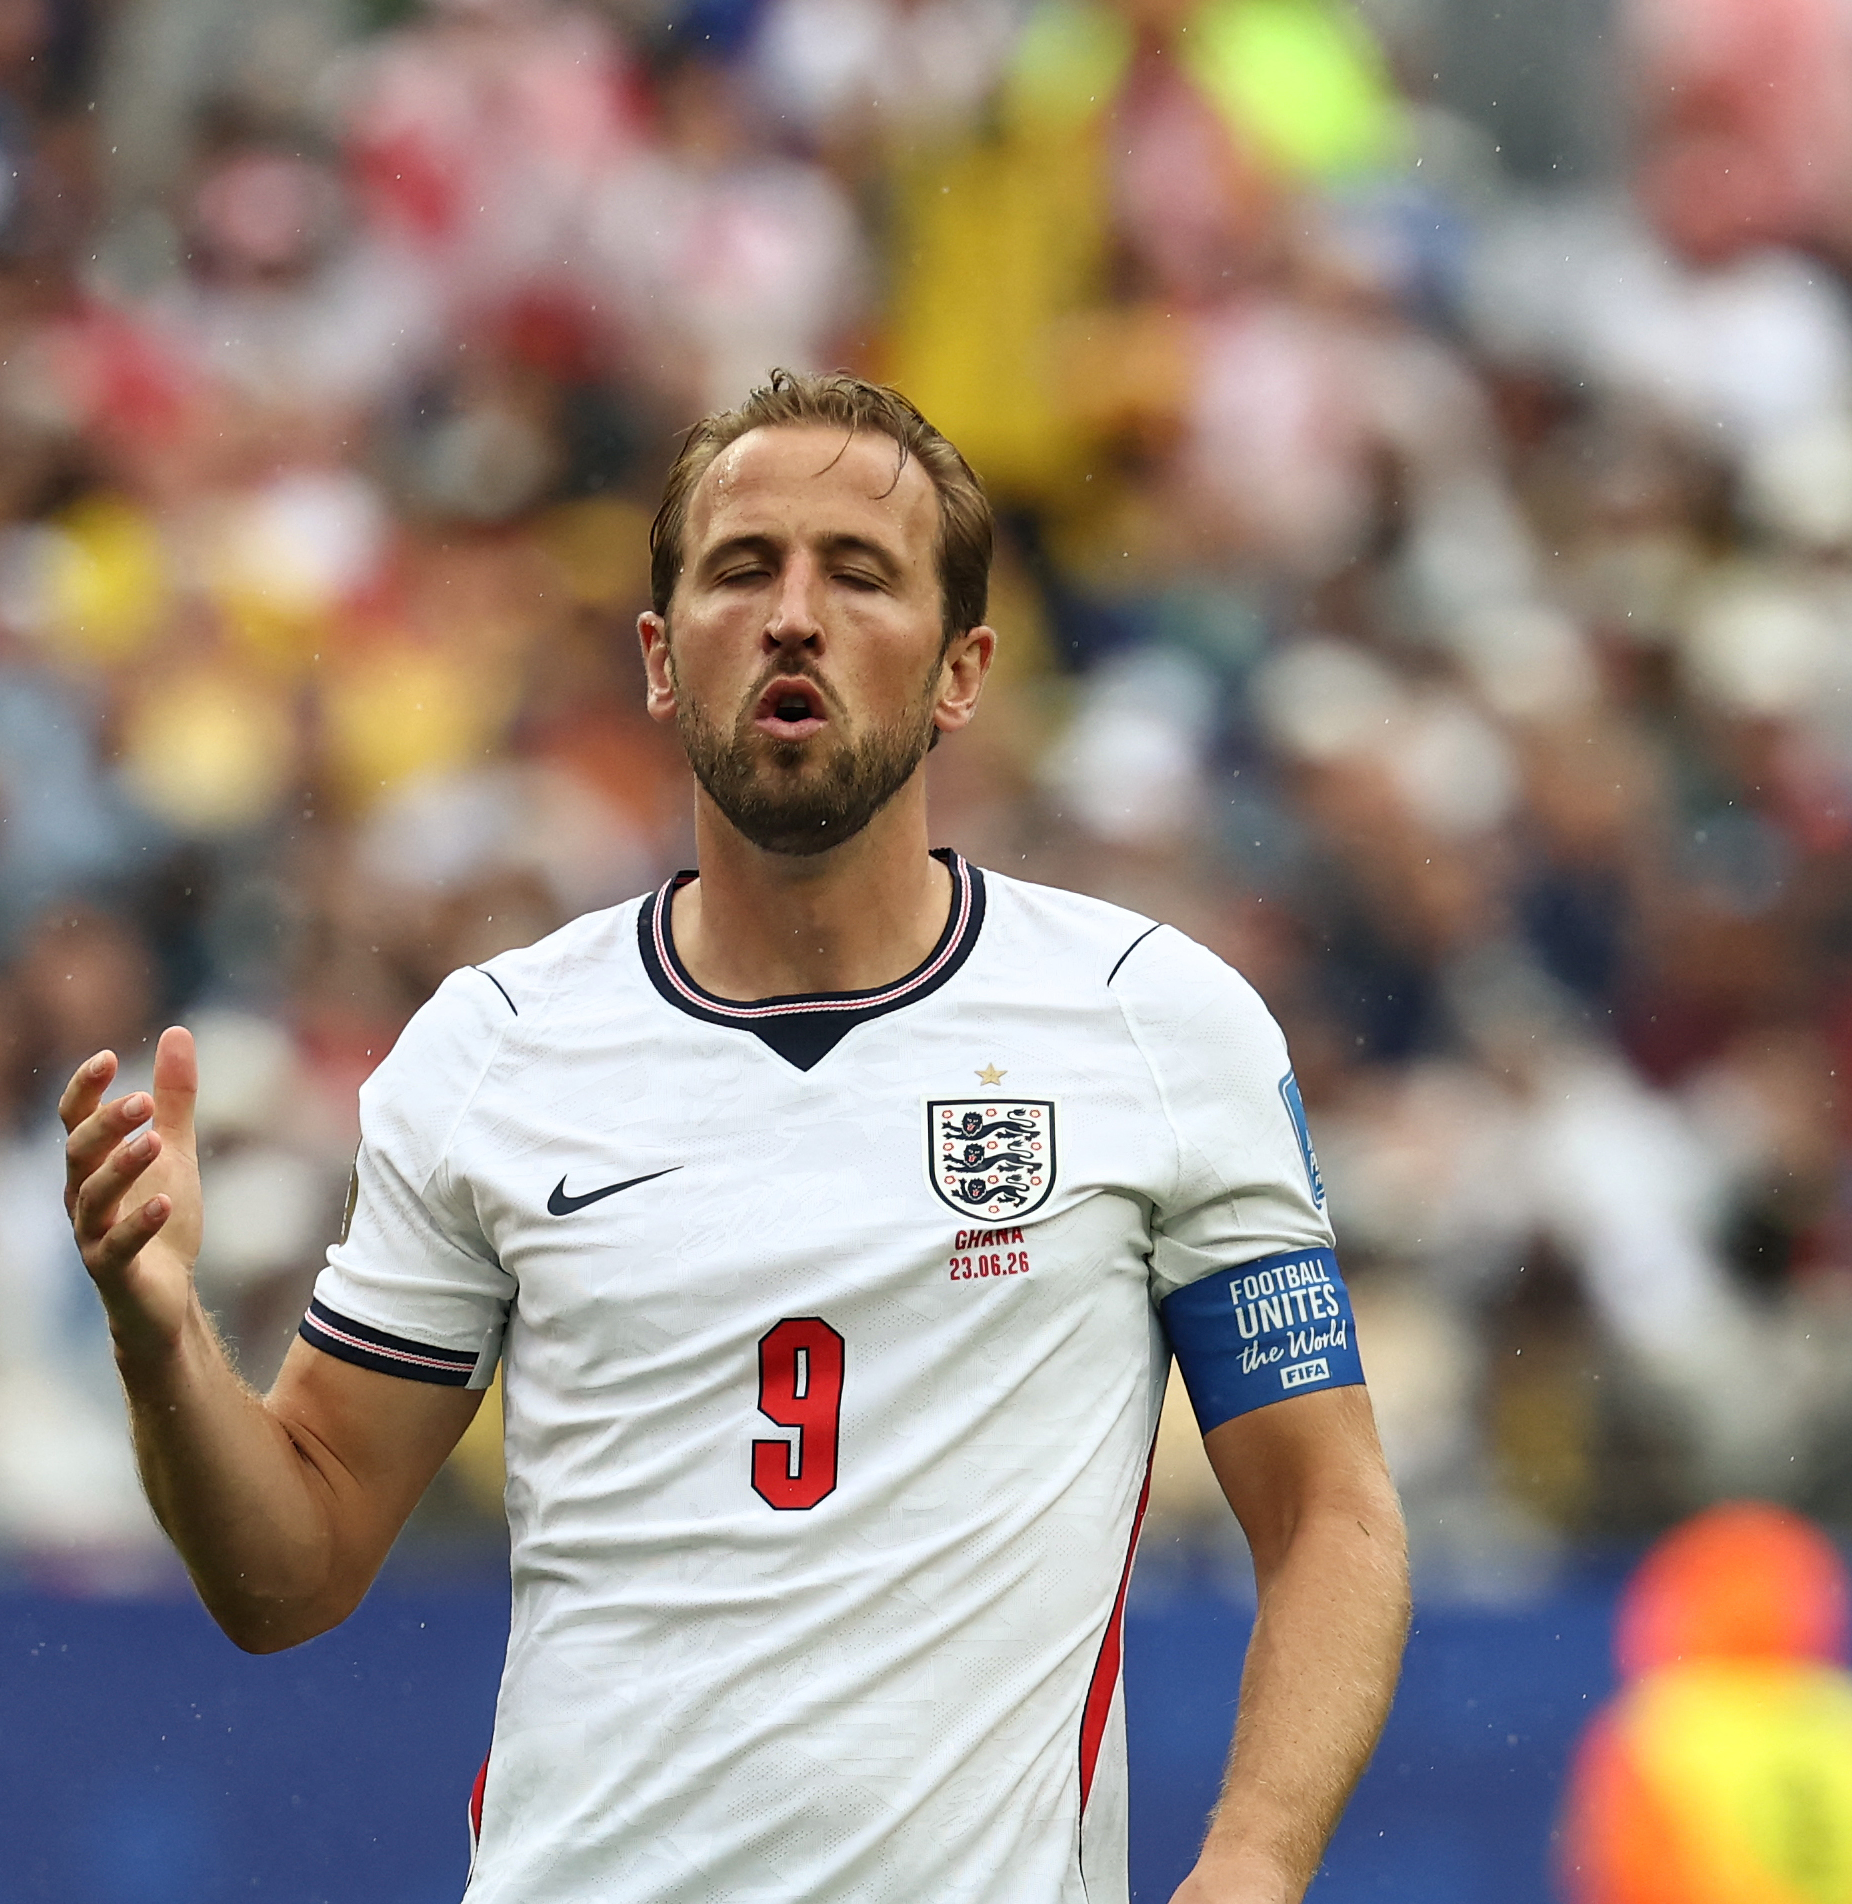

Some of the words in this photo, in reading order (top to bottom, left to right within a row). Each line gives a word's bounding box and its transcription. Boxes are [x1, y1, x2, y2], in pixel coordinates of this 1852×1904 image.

[955, 1226, 1024, 1250] GHANA
[949, 1251, 1029, 1280] 23.06.26
[1229, 1259, 1330, 1305] FOOTBALL
[1235, 1283, 1339, 1339] UNITES
[1236, 1340, 1284, 1374] the
[1287, 1319, 1347, 1358] World
[1285, 1362, 1326, 1384] FIFA
[751, 1317, 845, 1510] 9
